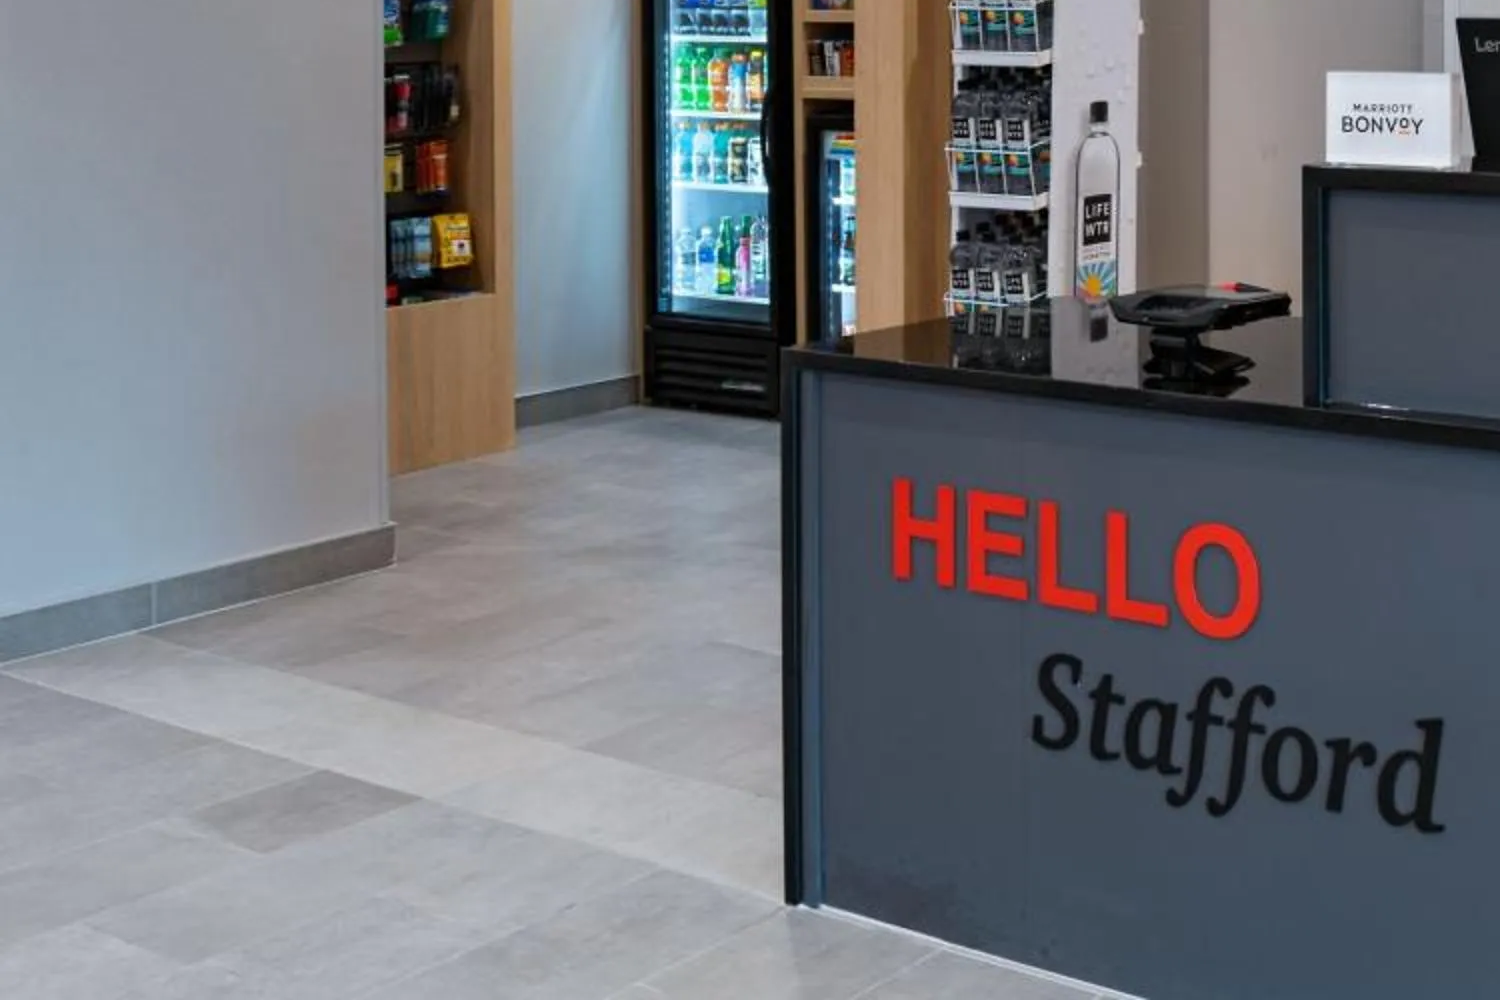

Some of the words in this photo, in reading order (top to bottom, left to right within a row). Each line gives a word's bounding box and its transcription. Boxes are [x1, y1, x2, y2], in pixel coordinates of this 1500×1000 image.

[1341, 116, 1424, 135] BONVOY
[1353, 103, 1413, 114] MARRIOTT
[892, 477, 1262, 640] HELLO
[1031, 652, 1446, 834] Stafford
